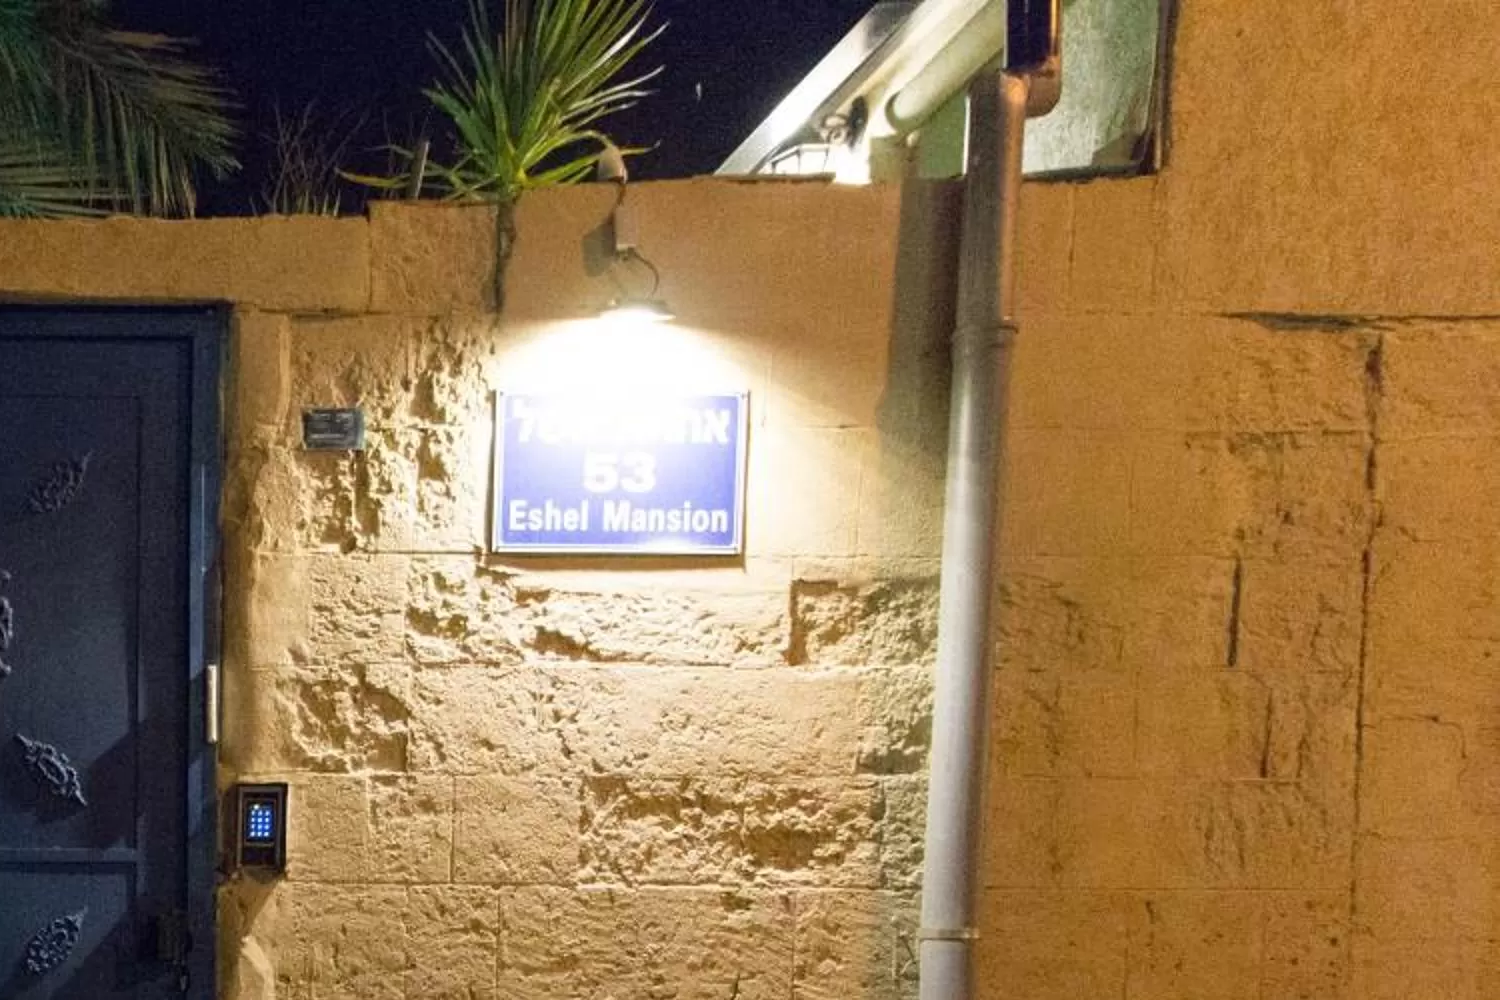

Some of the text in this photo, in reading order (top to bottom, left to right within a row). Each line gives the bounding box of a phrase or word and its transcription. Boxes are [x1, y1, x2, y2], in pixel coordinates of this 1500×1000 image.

[584, 451, 655, 493] 53
[509, 499, 728, 533] Eshel Mansion
